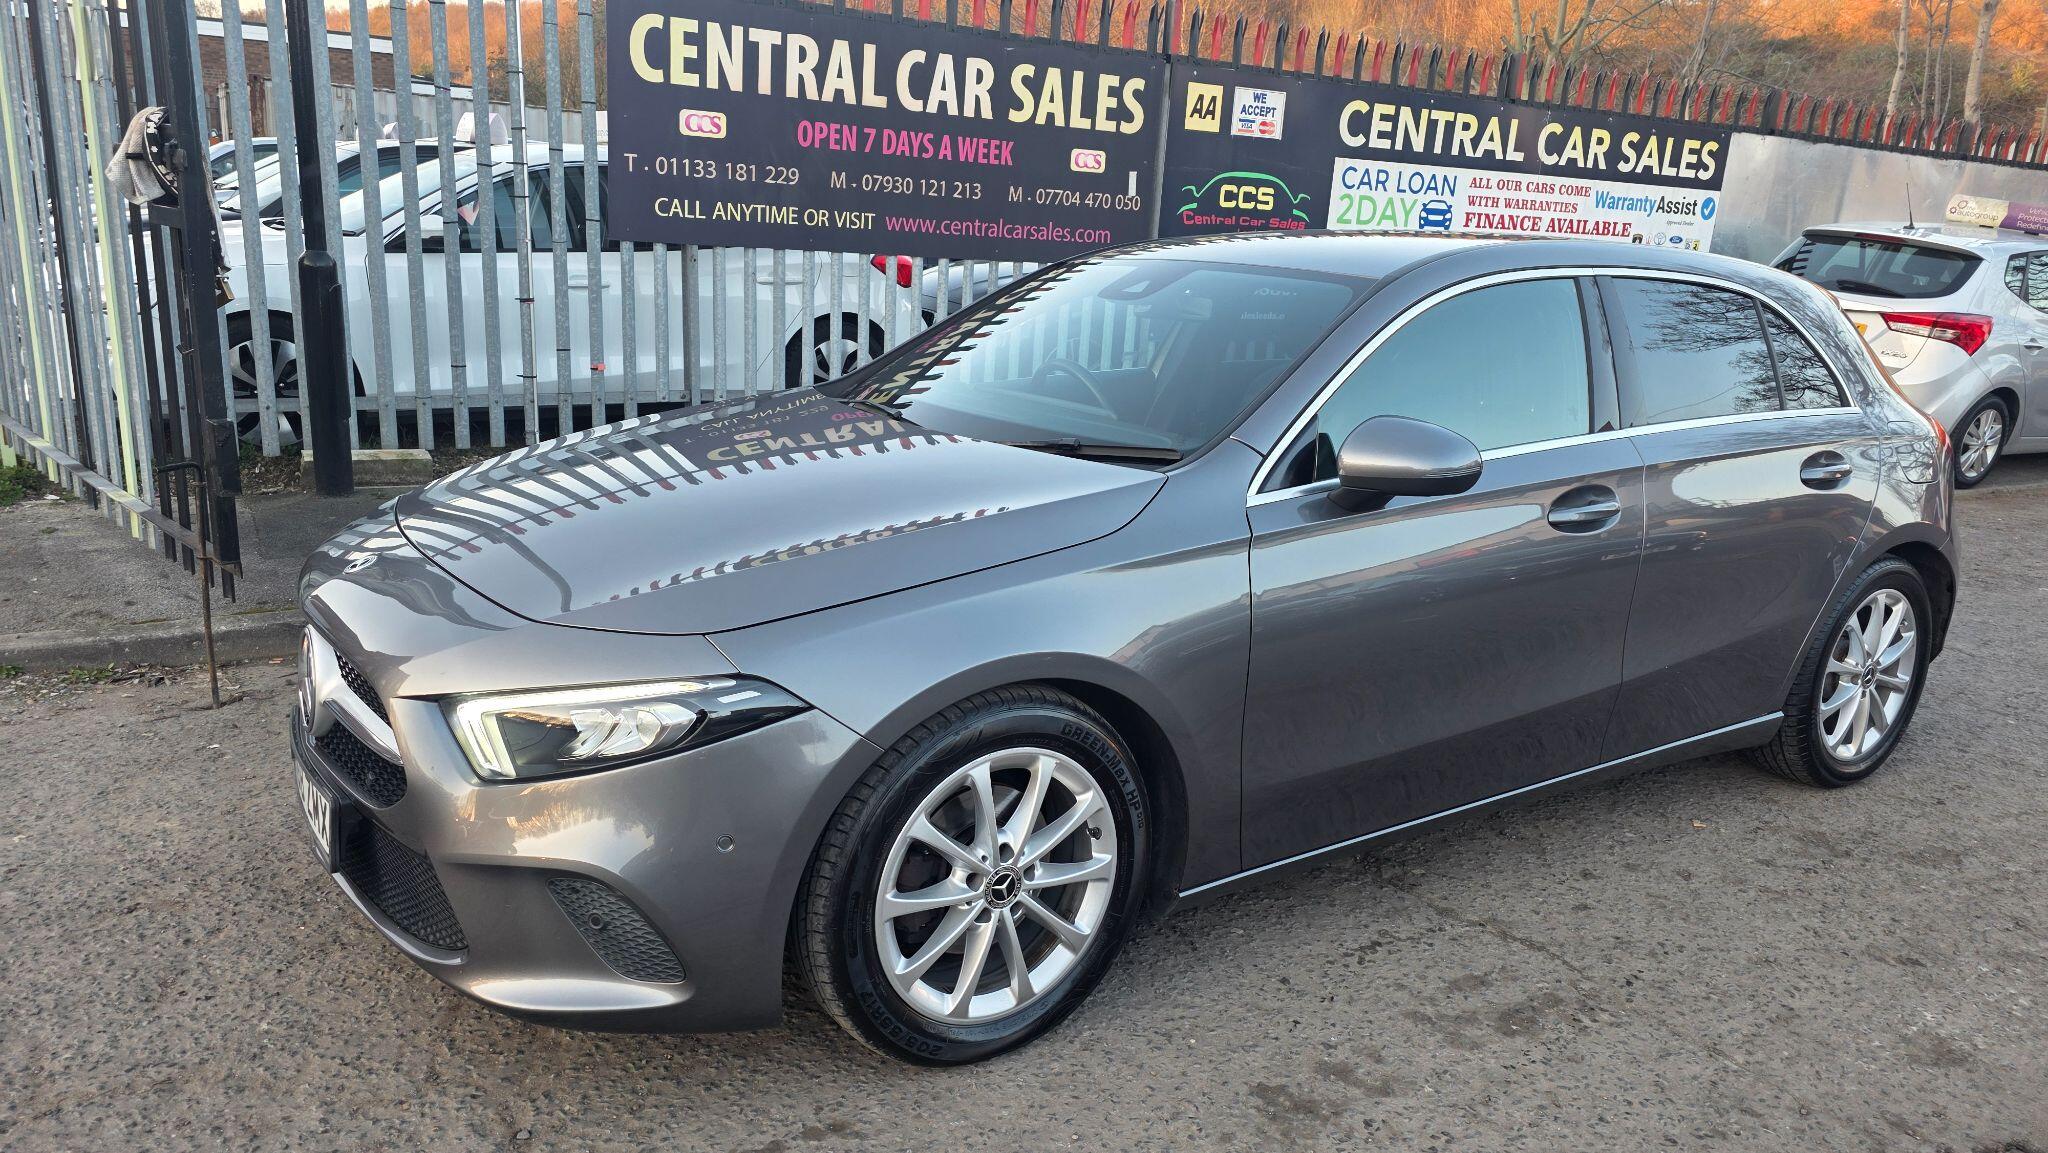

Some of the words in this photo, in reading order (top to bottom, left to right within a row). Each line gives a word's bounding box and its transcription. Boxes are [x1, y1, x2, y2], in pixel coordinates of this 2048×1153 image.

[630, 13, 888, 108] CENTRAL
[896, 49, 995, 120] CAR
[1008, 64, 1146, 134] SALES
[1190, 94, 1218, 121] AA
[1240, 104, 1277, 118] ACCEPT
[1253, 92, 1268, 104] WE
[684, 114, 722, 134] CCS
[797, 120, 857, 152] OPEN
[863, 128, 876, 152] 7
[882, 128, 934, 159] DAYS
[938, 134, 952, 161] A
[958, 136, 1015, 166] WEEK
[1339, 100, 1525, 162] CENTRAL
[1538, 122, 1611, 170] CAR
[1617, 132, 1720, 181] SALES
[655, 156, 718, 179] 01133
[726, 162, 756, 182] 181
[764, 166, 800, 185] 229
[1074, 152, 1102, 170] CCS
[862, 174, 914, 194] 07930
[920, 178, 946, 197] 121
[952, 182, 982, 200] 213
[1341, 166, 1390, 192] CAR
[1396, 170, 1458, 197] LOAN
[1469, 177, 1493, 190] ALL
[1496, 178, 1522, 192] OUR
[1526, 181, 1556, 195] CARS
[1558, 184, 1592, 198] COME
[1036, 188, 1080, 207] 07704
[1084, 192, 1111, 209] 470
[1116, 194, 1141, 211] 050
[1220, 184, 1275, 211] CCS
[1336, 193, 1419, 228] 2DAY
[1468, 194, 1500, 208] WITH
[1504, 198, 1579, 214] WARRANTIES
[1594, 190, 1698, 218] WarrantyAssist
[654, 198, 706, 220] CALL
[712, 202, 799, 225] ANYTIME
[804, 208, 830, 228] OR
[834, 210, 876, 230] VISIT
[885, 216, 1111, 244] www.centralcarsales.com
[1182, 210, 1236, 225] Central
[1240, 216, 1266, 227] Car
[1269, 217, 1306, 230] Sales
[1462, 212, 1543, 232] FINANCE
[1545, 216, 1632, 238] AVAILABLE
[1956, 210, 1999, 222] autogroup
